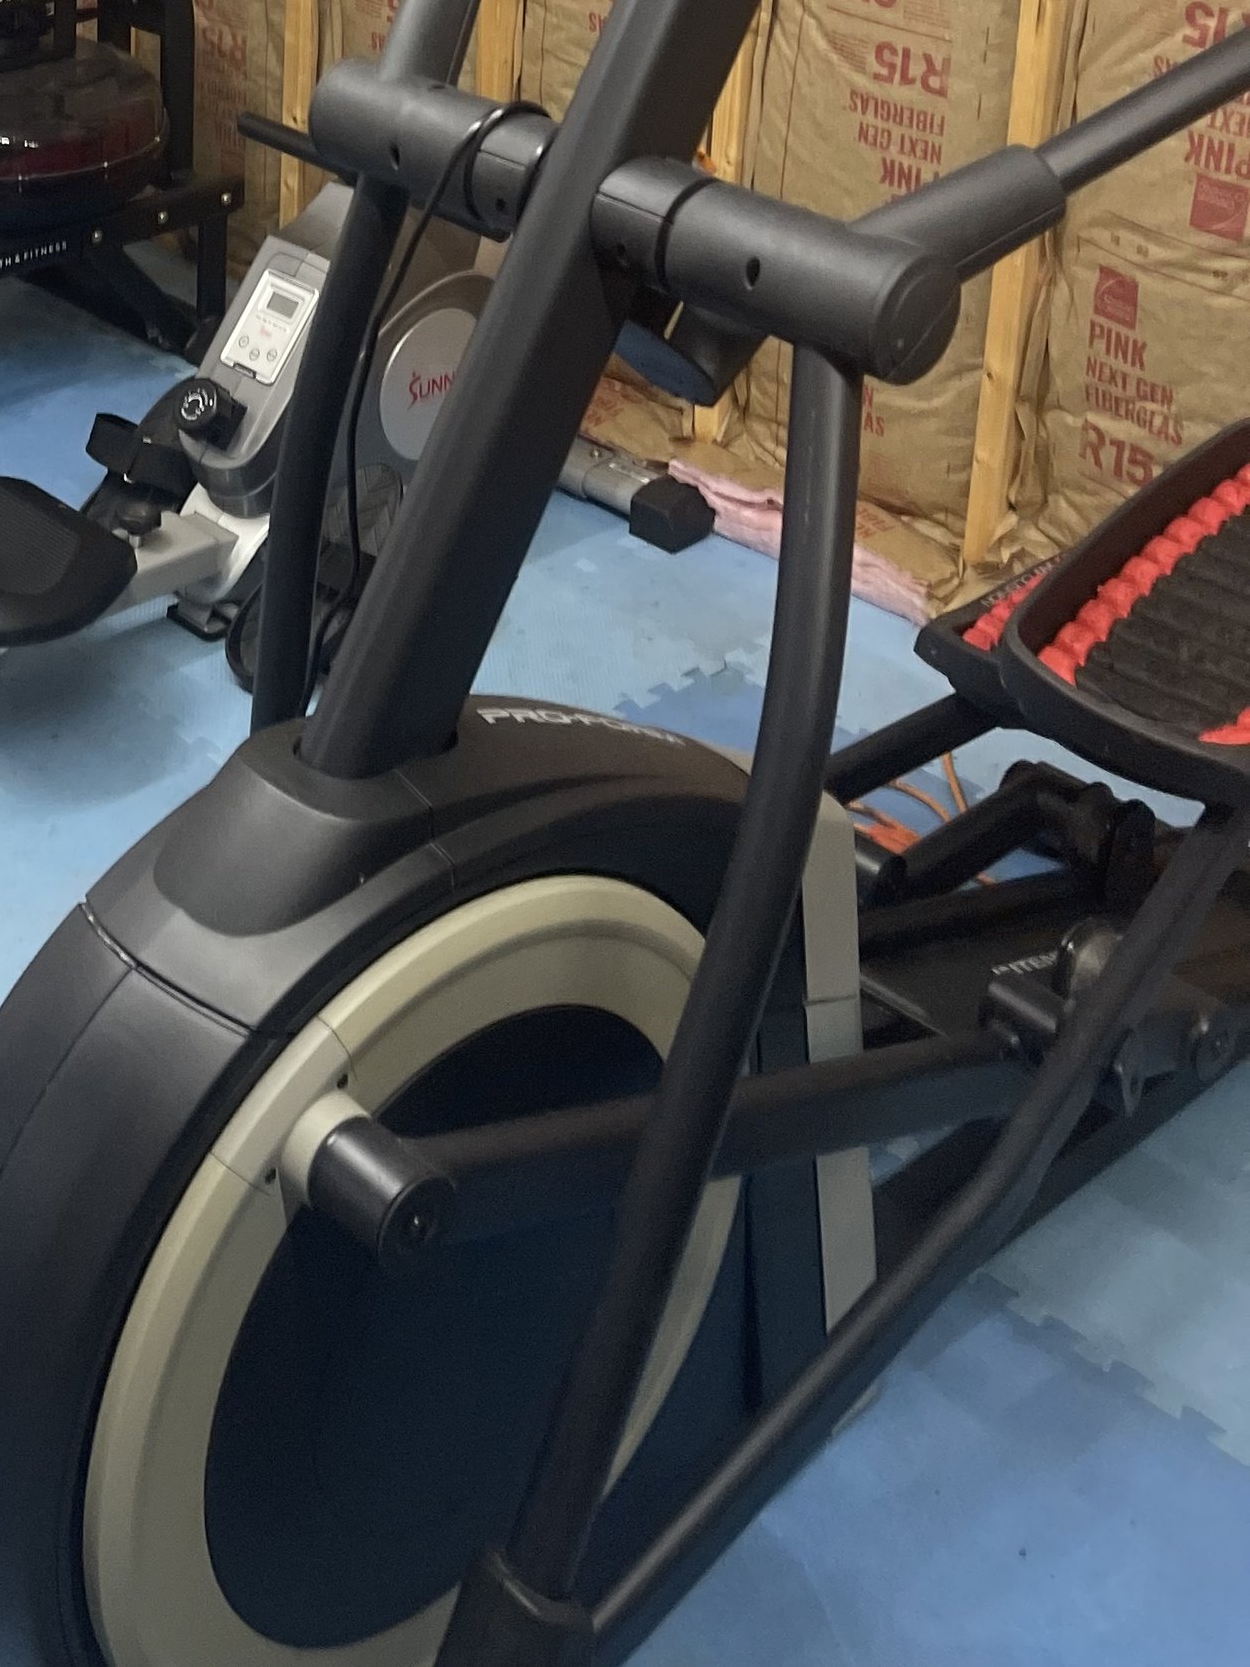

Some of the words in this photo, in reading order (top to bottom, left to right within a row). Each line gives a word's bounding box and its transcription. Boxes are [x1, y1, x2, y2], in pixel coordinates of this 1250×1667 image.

[1182, 0, 1250, 50] 15
[872, 40, 950, 99] R15
[849, 88, 945, 137] FIBERGLAS
[858, 121, 892, 151] GEN
[897, 133, 942, 166] NEXT
[1184, 128, 1250, 181] PINK
[14, 253, 21, 264] &
[23, 240, 67, 260] FITNESS
[1088, 317, 1148, 372] PINK
[408, 370, 455, 410] SUNN
[1085, 355, 1129, 393] NEXT
[1135, 376, 1174, 412] GEN
[1085, 383, 1184, 447] FIBERGLAS
[1077, 417, 1156, 485] R15
